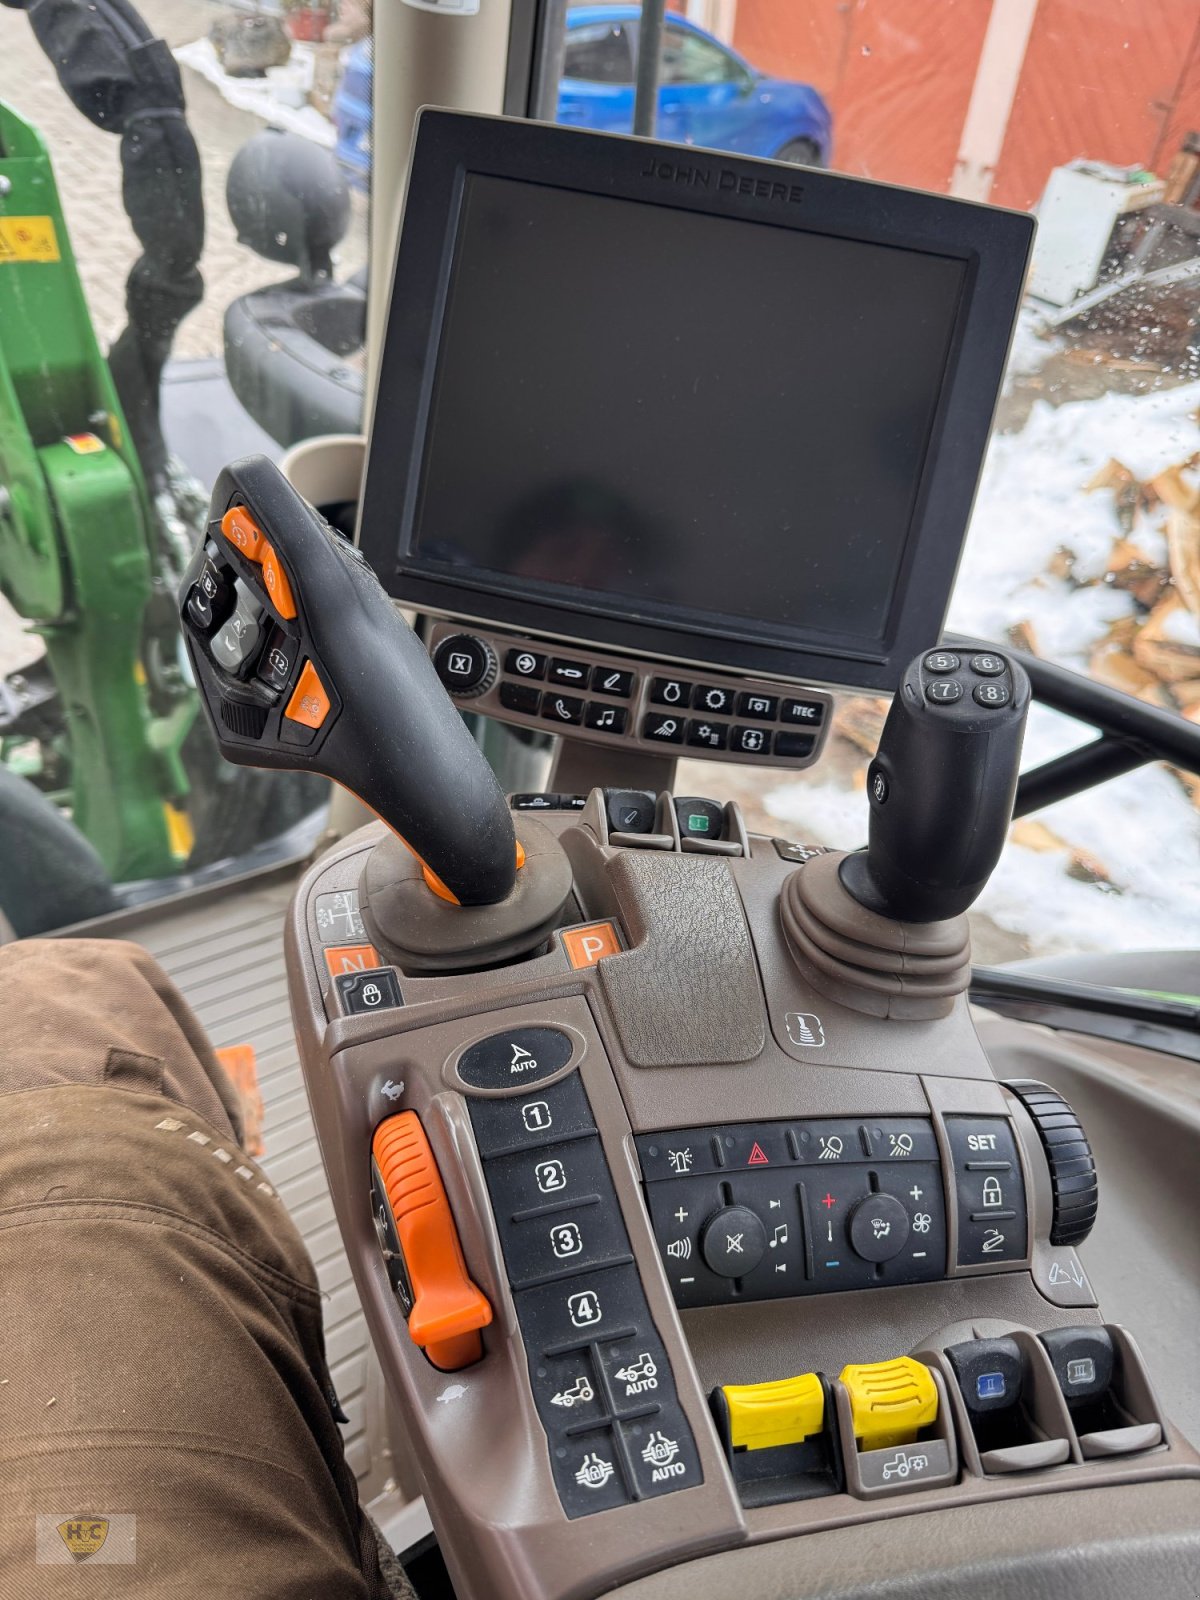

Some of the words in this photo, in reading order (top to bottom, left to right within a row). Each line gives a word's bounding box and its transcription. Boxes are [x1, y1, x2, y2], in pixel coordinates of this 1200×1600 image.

[640, 158, 710, 187] JOHN
[716, 170, 804, 203] DEERE
[275, 655, 285, 670] 12
[455, 657, 466, 670] X
[937, 656, 948, 667] 5
[982, 658, 993, 669] 6
[940, 683, 950, 697] 7
[986, 686, 998, 699] 8
[792, 704, 816, 718] iTEC
[580, 937, 603, 962] P
[341, 954, 366, 974] N
[510, 1059, 537, 1074] AUTO
[530, 1106, 544, 1126] 1
[889, 1134, 896, 1145] 2
[967, 1134, 996, 1150] SET
[543, 1167, 560, 1188] 2
[558, 1230, 574, 1251] 3
[577, 1298, 593, 1320] 4
[626, 1377, 658, 1396] AUTO
[652, 1462, 686, 1482] AUTO
